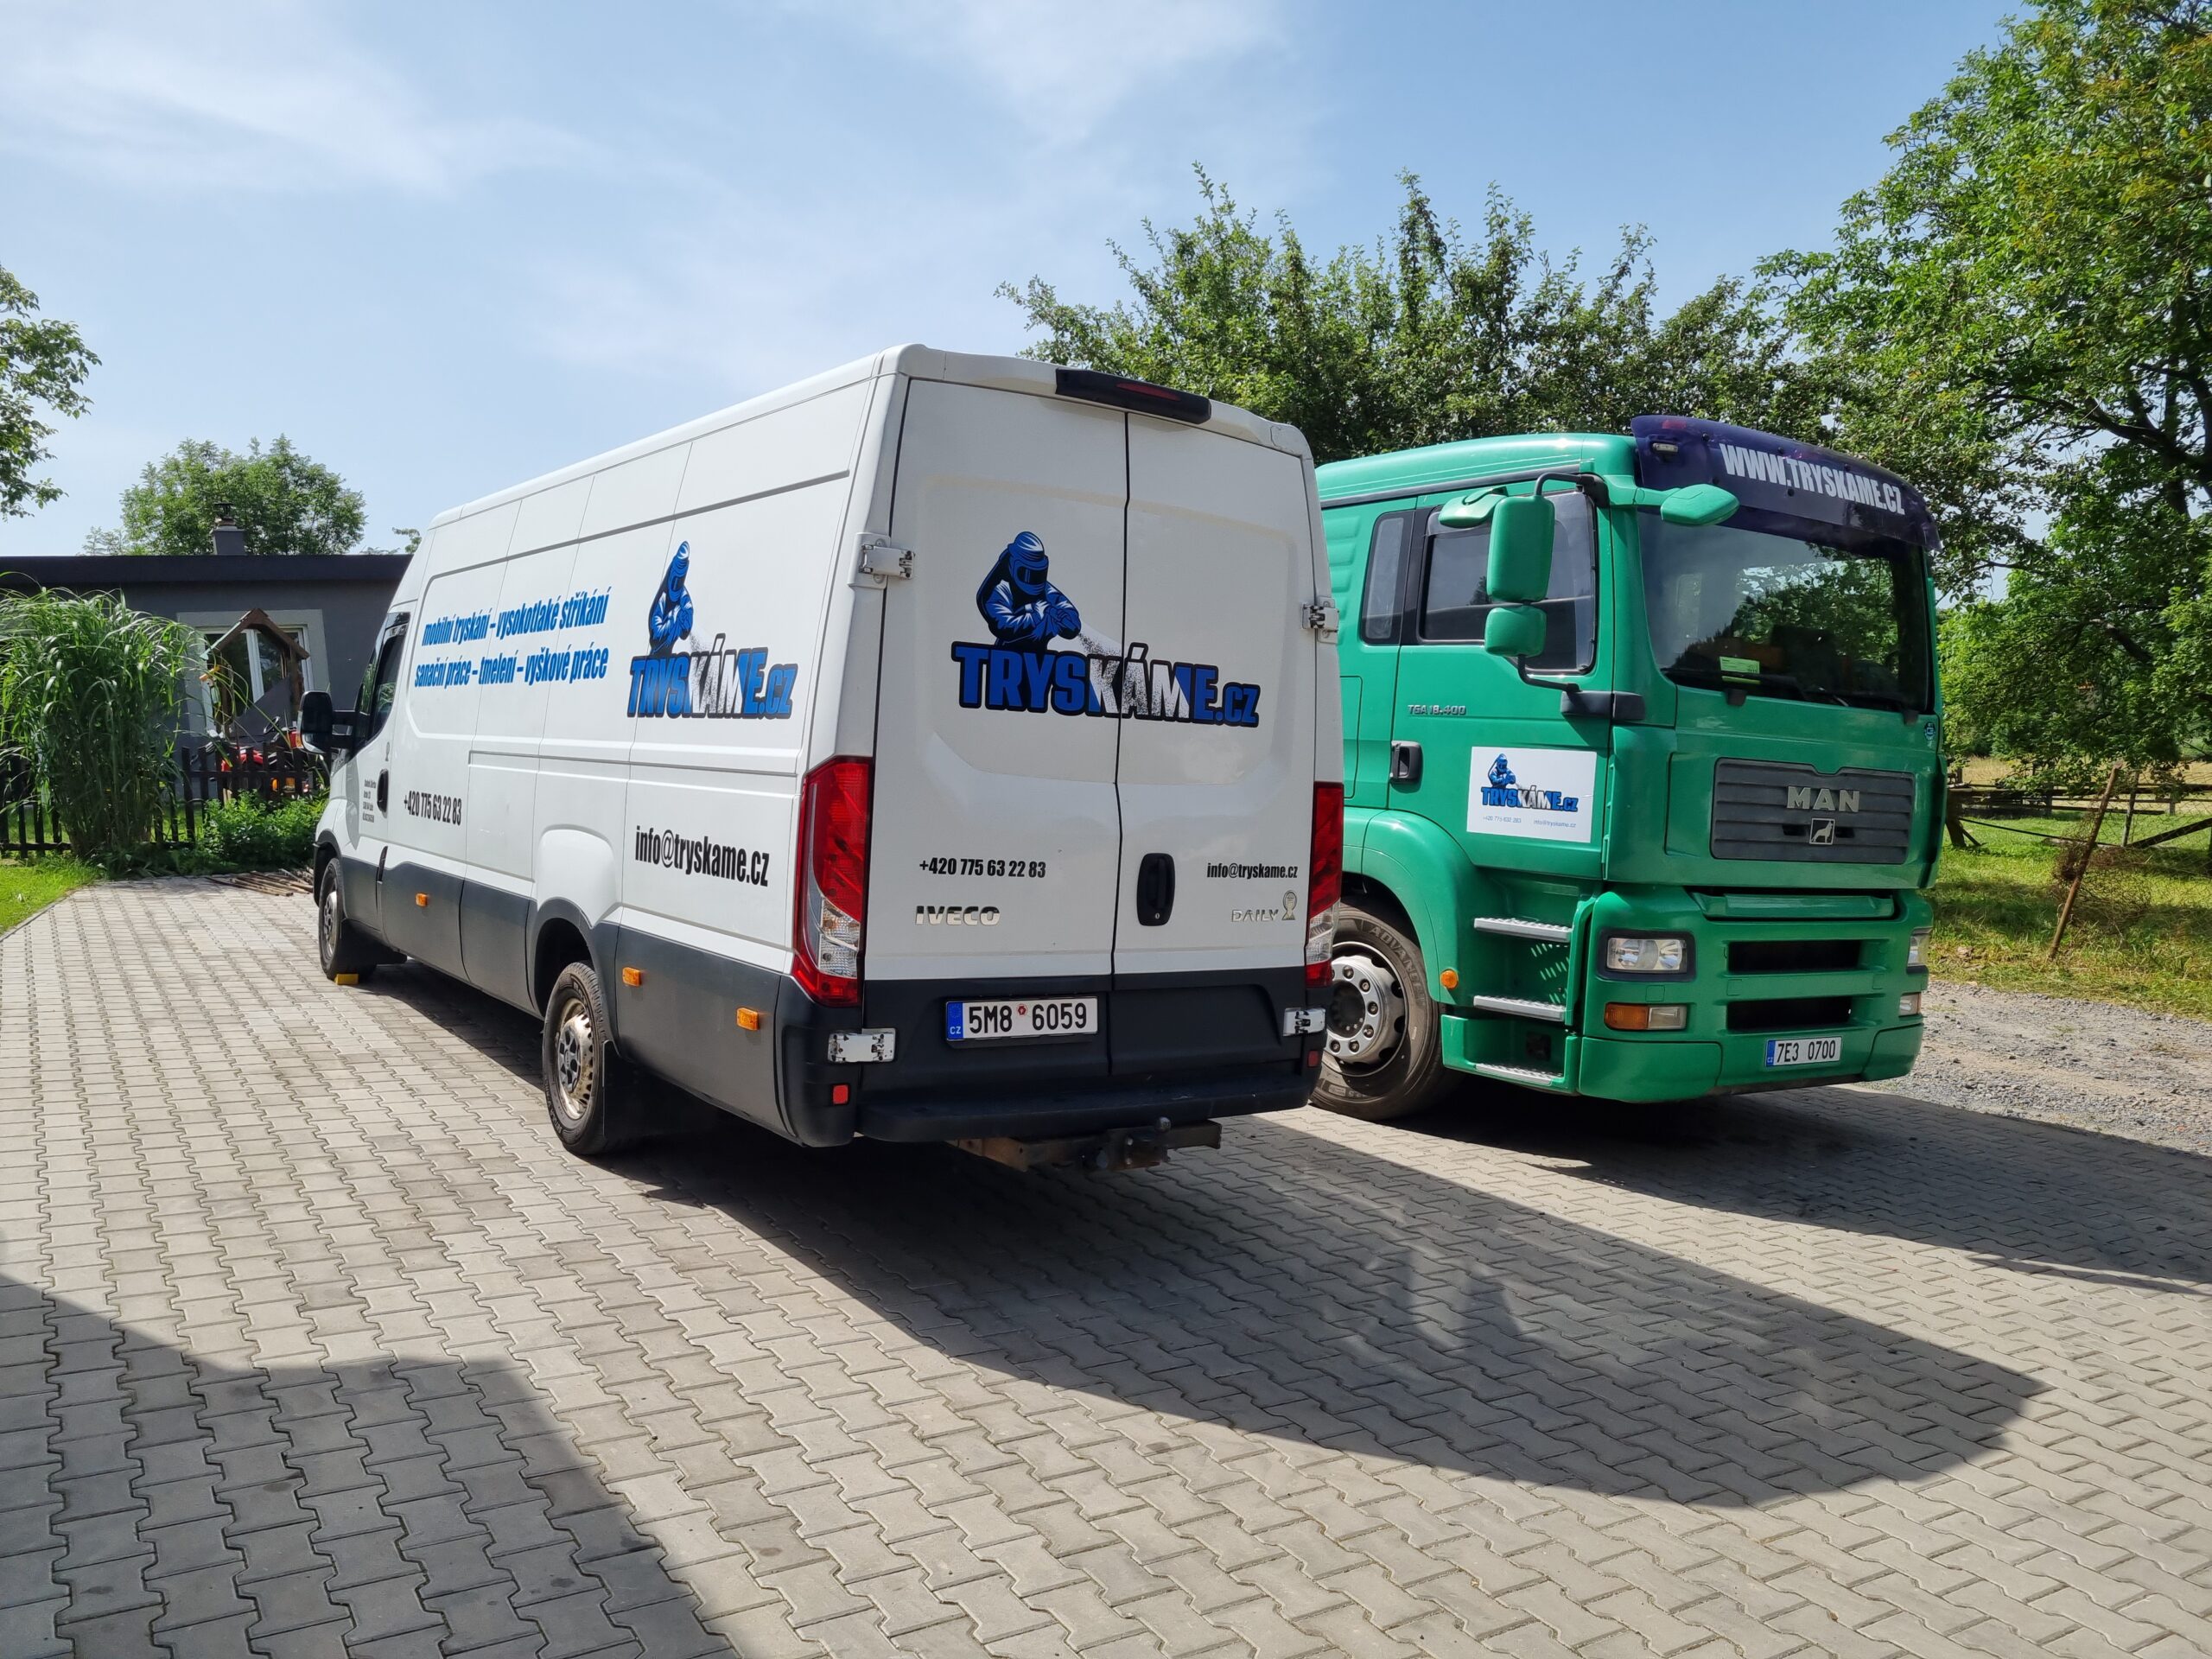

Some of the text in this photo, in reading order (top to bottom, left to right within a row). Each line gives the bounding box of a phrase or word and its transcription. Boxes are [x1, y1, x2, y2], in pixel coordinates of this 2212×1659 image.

[1719, 443, 1905, 515] WWW.TRYSKAME.CZ
[422, 613, 456, 646] mobilní
[452, 607, 493, 645] tryskání
[495, 594, 561, 640] vysokotlaké
[559, 586, 612, 630] stříkání
[414, 657, 448, 688] sanační
[444, 655, 472, 690] práce
[478, 650, 518, 685] tmelení
[524, 646, 571, 686] vyškové
[569, 641, 609, 684] práce
[404, 790, 420, 817] +420
[421, 791, 432, 819] 775
[432, 794, 442, 822] 63
[442, 795, 451, 823] 22
[452, 797, 462, 826] 83
[1786, 785, 1860, 812] MAN
[635, 825, 770, 887] info@tryskame.cz
[919, 857, 1046, 878] +420 775 63 22 83
[1206, 862, 1299, 880] info@tryskame.cz
[915, 906, 1001, 926] IVECO
[1231, 909, 1279, 922] DAILY
[950, 1002, 1087, 1035] CZ 5M8 6059
[1777, 1042, 1799, 1063] 7E3
[1808, 1039, 1835, 1060] 0700
